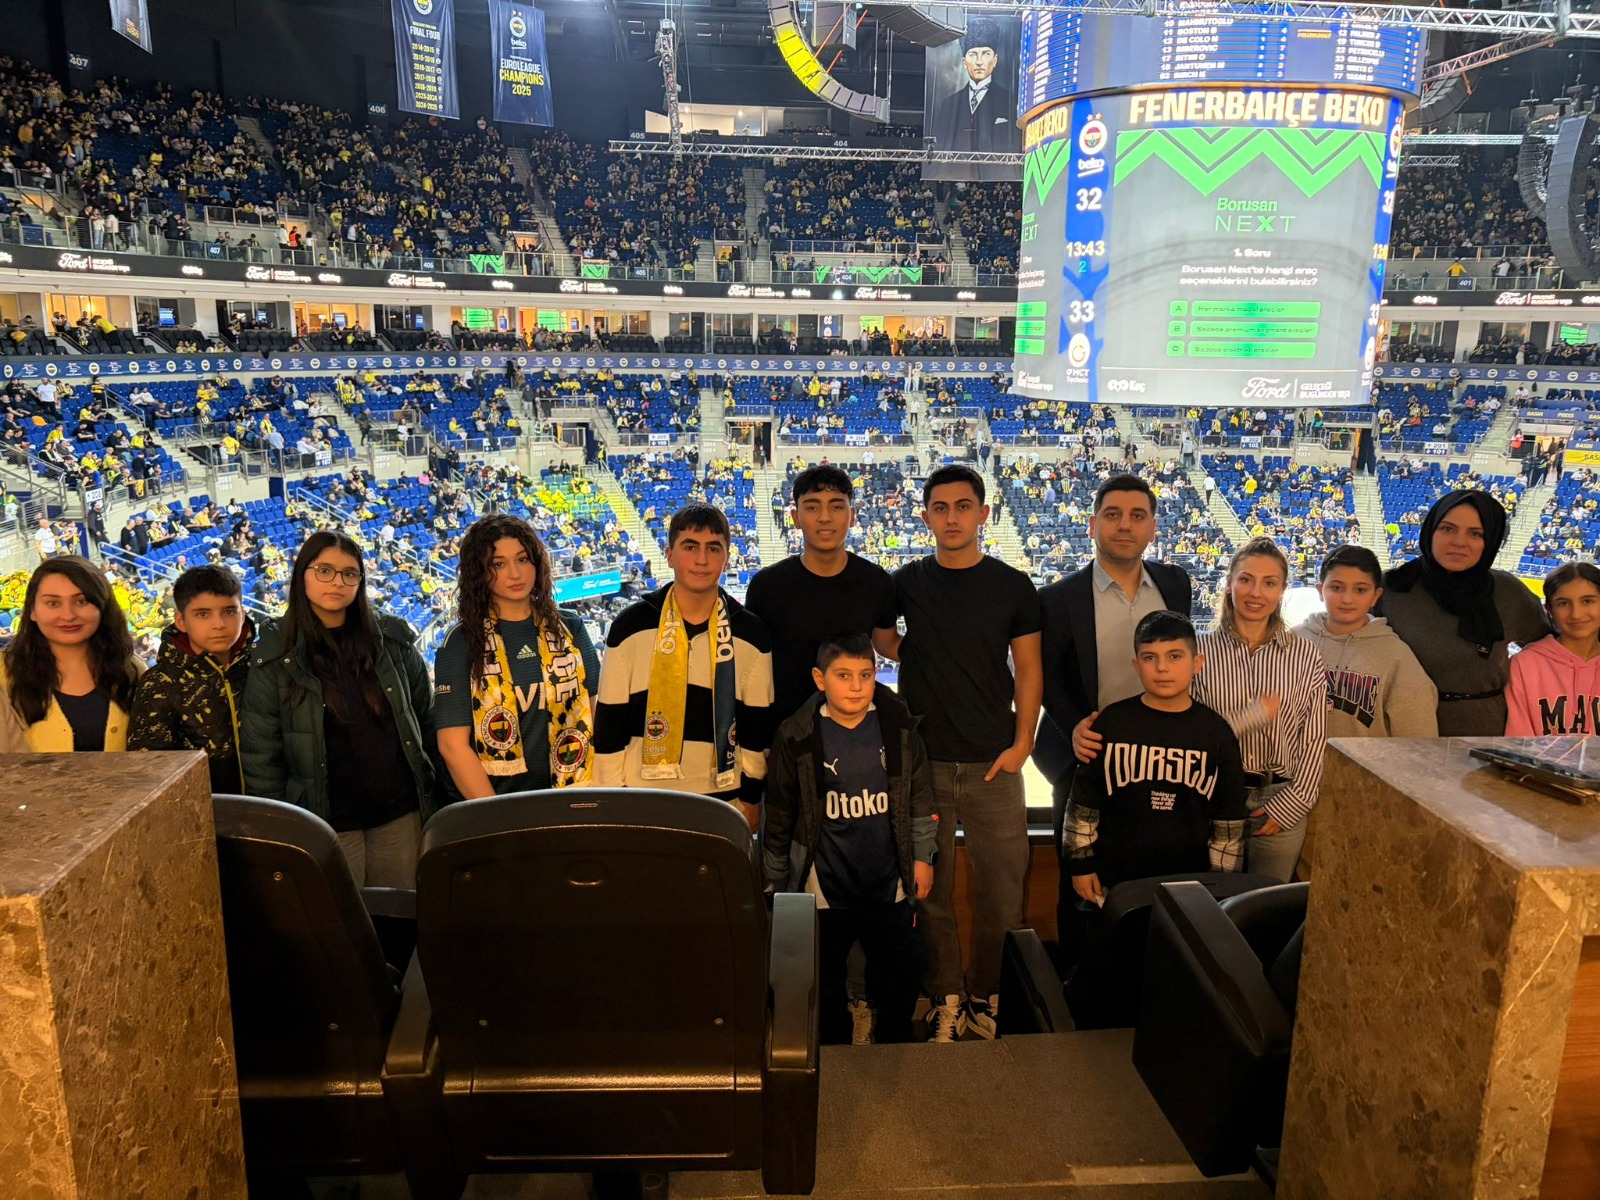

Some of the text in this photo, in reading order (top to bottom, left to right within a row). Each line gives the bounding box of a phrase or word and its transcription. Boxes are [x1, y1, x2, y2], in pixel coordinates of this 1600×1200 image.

[410, 26, 441, 41] FINAL FOUR
[412, 43, 435, 53] 2014-2015
[511, 38, 527, 48] beko
[69, 56, 88, 67] 407
[501, 58, 541, 74] EUROLEAGUE
[500, 69, 544, 86] CHAMPIONS
[512, 84, 532, 96] 2025
[1130, 91, 1385, 128] FENERBAHÇE BEKO
[630, 132, 645, 140] 405
[1078, 157, 1105, 171] beko
[1076, 188, 1102, 210] 32
[1217, 197, 1278, 212] Borusan
[1214, 215, 1296, 233] NEXT
[209, 247, 220, 255] 407
[1066, 241, 1105, 258] 13:43
[1234, 248, 1272, 258] 1. Soru
[58, 252, 88, 269] Ford
[423, 261, 434, 269] 406
[1078, 261, 1086, 274] 2
[246, 265, 271, 281] Ford
[636, 269, 646, 277] 405
[1182, 265, 1226, 274] Borusan
[1265, 266, 1293, 276] hangi
[1376, 263, 1383, 276] 2
[387, 273, 411, 288] Ford
[1459, 279, 1472, 287] 401
[1495, 291, 1527, 306] Ford
[1070, 300, 1094, 323] 33
[1241, 377, 1291, 399] Ford
[516, 652, 537, 660] adidas
[826, 789, 889, 820] Otoko
